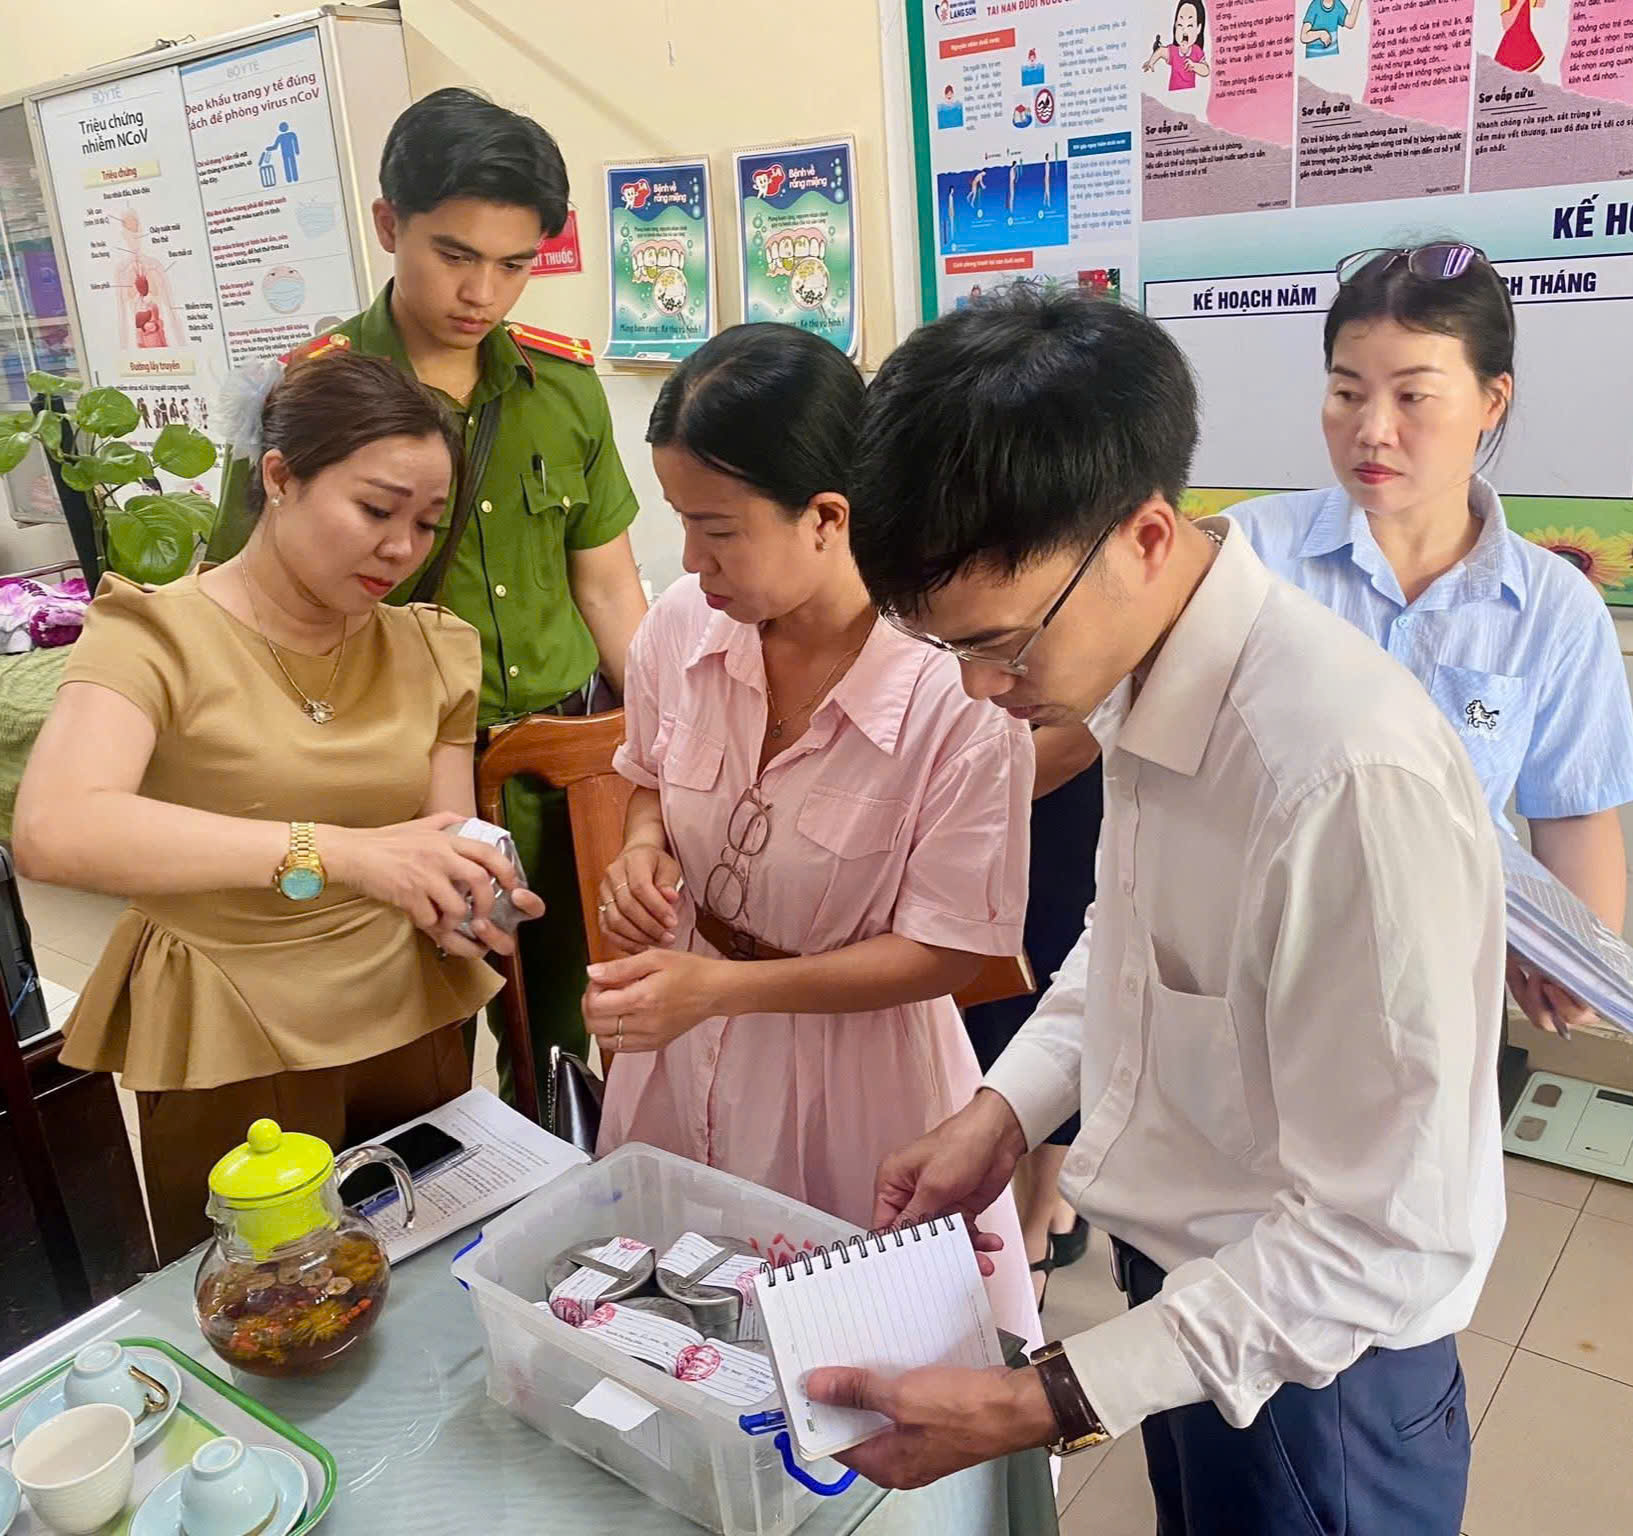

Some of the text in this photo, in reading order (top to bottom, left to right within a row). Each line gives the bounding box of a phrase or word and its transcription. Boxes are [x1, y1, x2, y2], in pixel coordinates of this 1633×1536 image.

[233, 88, 261, 103] trang
[264, 85, 270, 96] y
[273, 79, 285, 92] tế
[287, 73, 316, 88] đúng
[1479, 93, 1493, 103] Sơ
[1495, 86, 1512, 103] cấp
[225, 105, 259, 123] phòng
[260, 97, 288, 112] virus
[290, 88, 320, 105] nCoV
[1302, 107, 1314, 116] Sơ
[1316, 101, 1331, 116] cấp
[79, 111, 144, 136] Triệu chứng
[1477, 120, 1498, 129] Nhanh
[1500, 117, 1521, 127] chóng
[117, 128, 148, 146] NCoV
[1553, 193, 1600, 239] KẾ
[544, 247, 573, 265] THUỐC
[1529, 269, 1596, 295] THÁNG
[1193, 284, 1316, 312] KẾ HOẠCH NĂM
